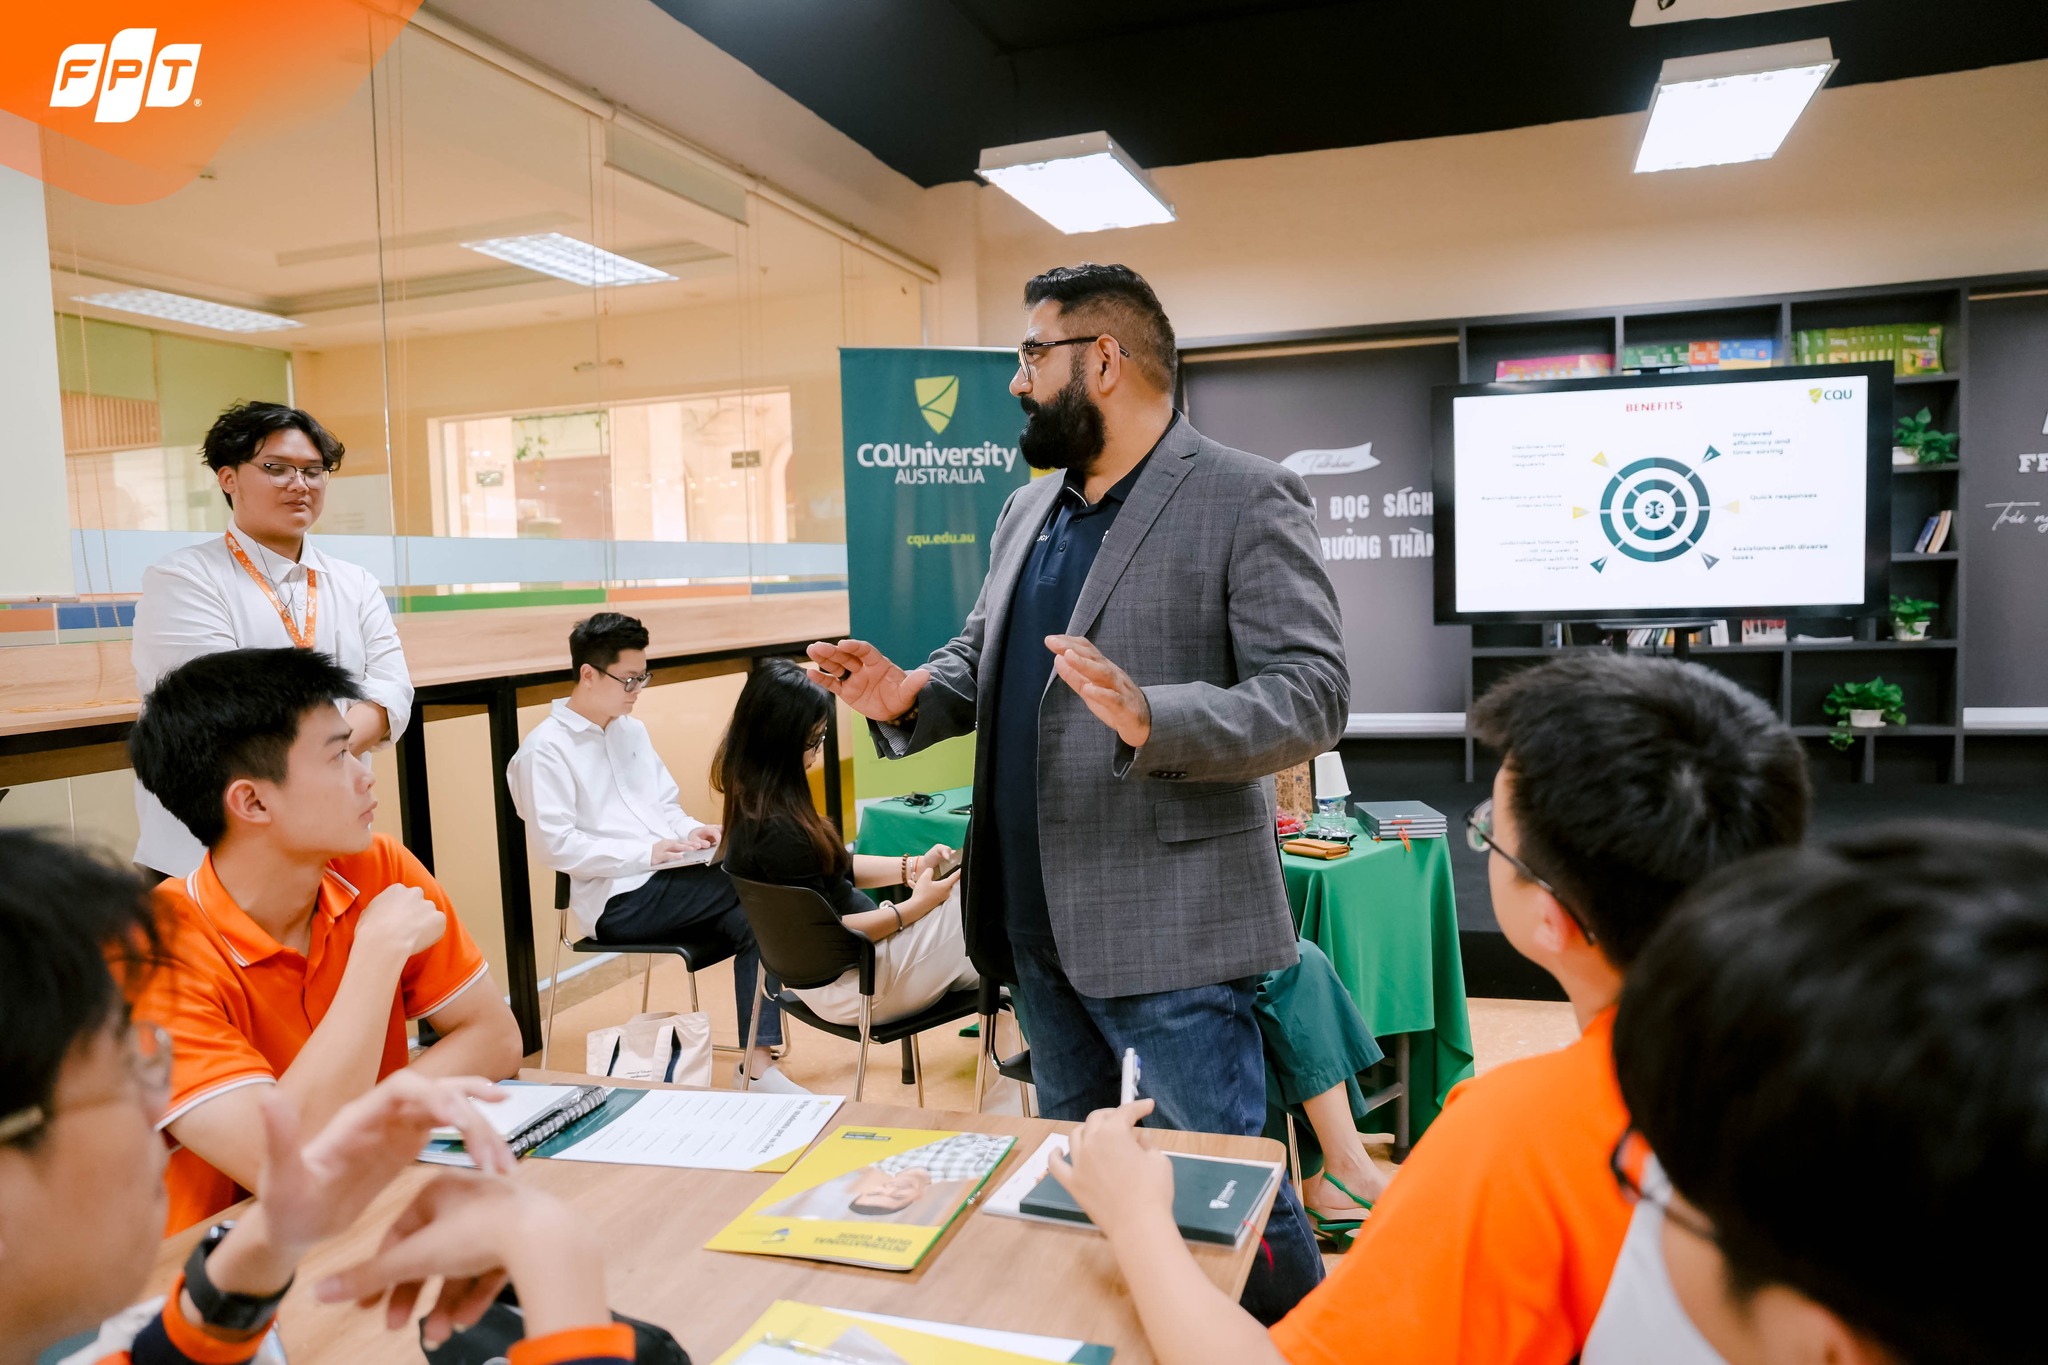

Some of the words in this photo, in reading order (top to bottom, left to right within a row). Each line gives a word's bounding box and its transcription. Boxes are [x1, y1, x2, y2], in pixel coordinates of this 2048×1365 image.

[1824, 388, 1853, 401] CQU
[1625, 400, 1684, 413] BENEFITS
[1732, 430, 1772, 438] Improved
[856, 440, 1018, 473] CQUniversity
[894, 468, 986, 485] AUSTRALIA
[1750, 493, 1773, 501] Quick
[1775, 492, 1818, 500] responses
[1329, 494, 1370, 523] ĐỌC
[1382, 486, 1434, 518] SÁCH
[906, 531, 976, 549] cqu.edu.au
[1778, 543, 1796, 551] with
[1797, 543, 1829, 551] diverse
